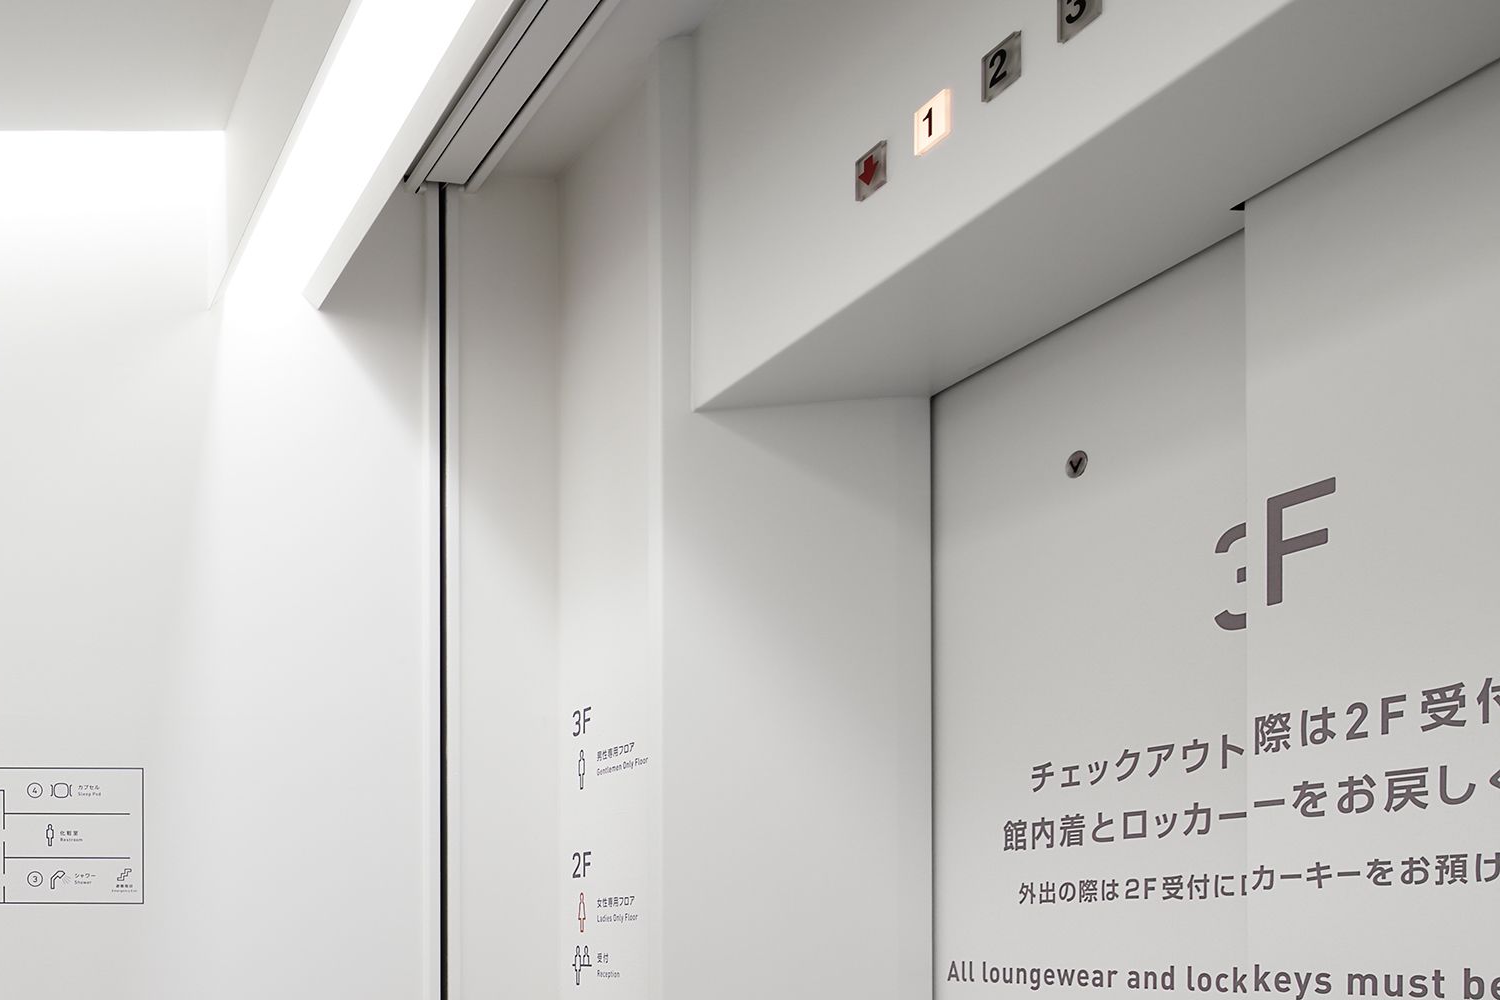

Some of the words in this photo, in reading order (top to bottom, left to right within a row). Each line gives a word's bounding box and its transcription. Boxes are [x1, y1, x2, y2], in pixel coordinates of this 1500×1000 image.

[1065, 0, 1087, 24] 3
[989, 49, 1007, 88] 2
[922, 106, 933, 138] 1
[572, 706, 592, 738] 3F
[572, 851, 592, 879] 2F
[624, 912, 639, 922] Floor
[596, 969, 620, 979] Reception
[946, 960, 975, 983] All
[982, 960, 1119, 991] loungewear
[1126, 965, 1175, 991] and
[1347, 969, 1446, 999] must
